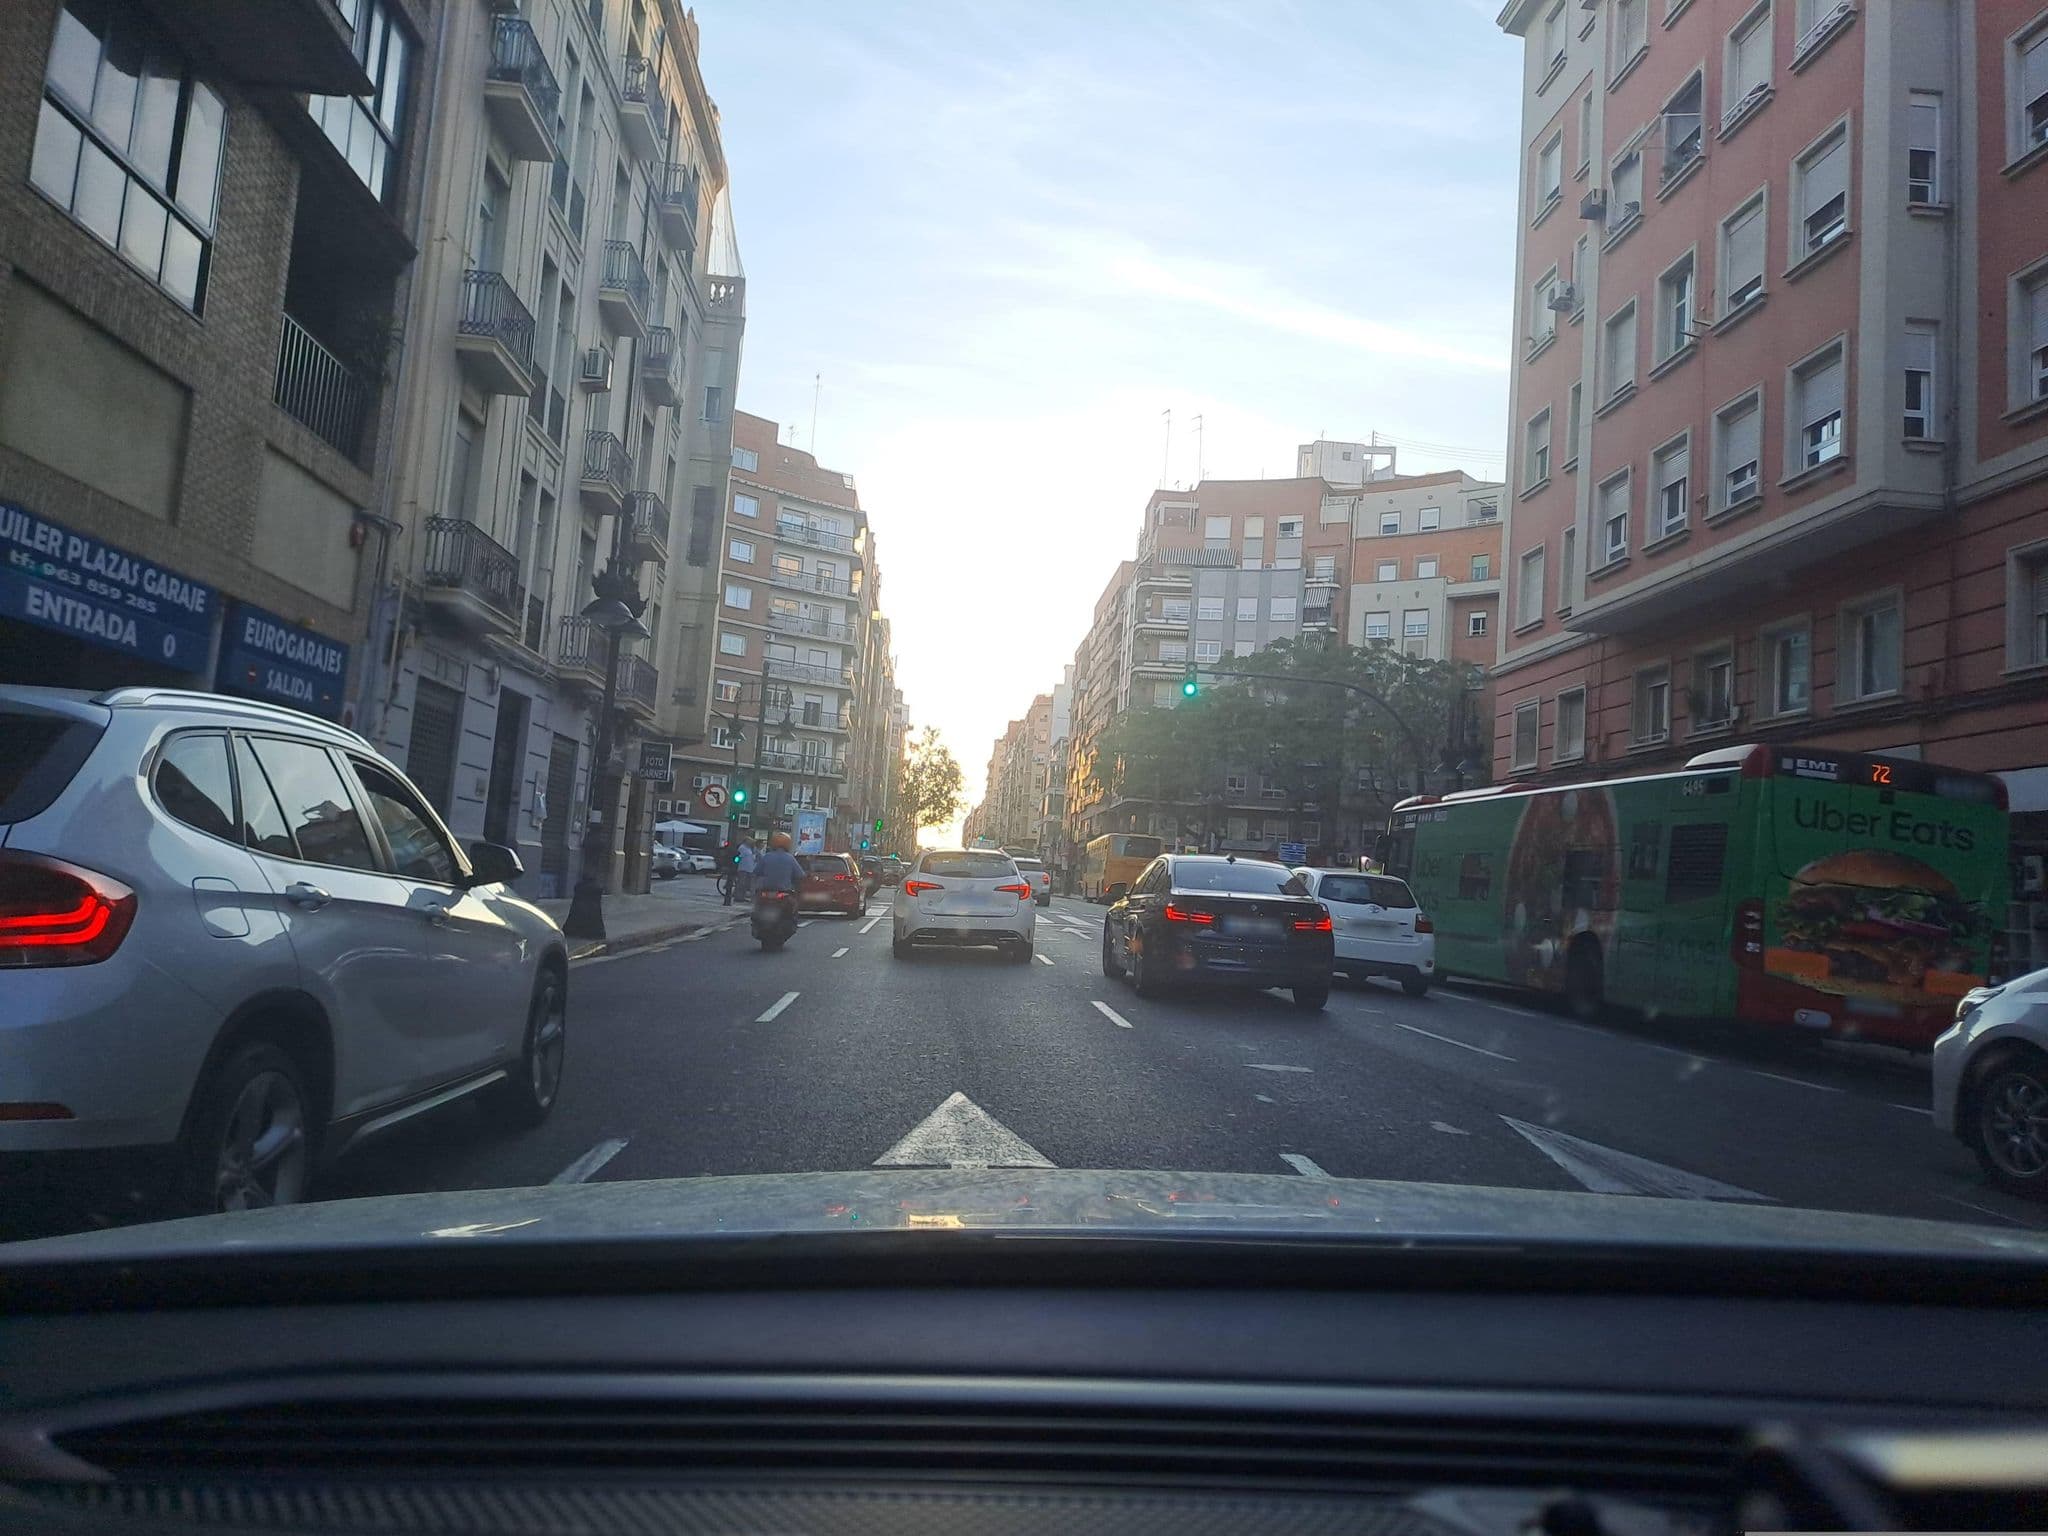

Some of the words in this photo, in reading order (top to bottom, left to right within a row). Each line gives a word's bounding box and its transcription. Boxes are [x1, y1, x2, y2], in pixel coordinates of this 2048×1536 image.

[43, 562, 82, 586] 963
[86, 578, 122, 600] 859
[125, 592, 158, 614] 285
[66, 534, 140, 587] PLAZAS
[143, 568, 206, 613] GARAJE
[25, 586, 137, 648] ENTRADA
[243, 616, 342, 674] EUROGARAJES
[266, 668, 313, 702] SALIDA
[645, 756, 664, 767] FOTO
[1795, 758, 1838, 772] EMT
[1871, 764, 1893, 784] 72
[1793, 797, 1882, 835] Uber
[1890, 810, 1975, 851] Eats
